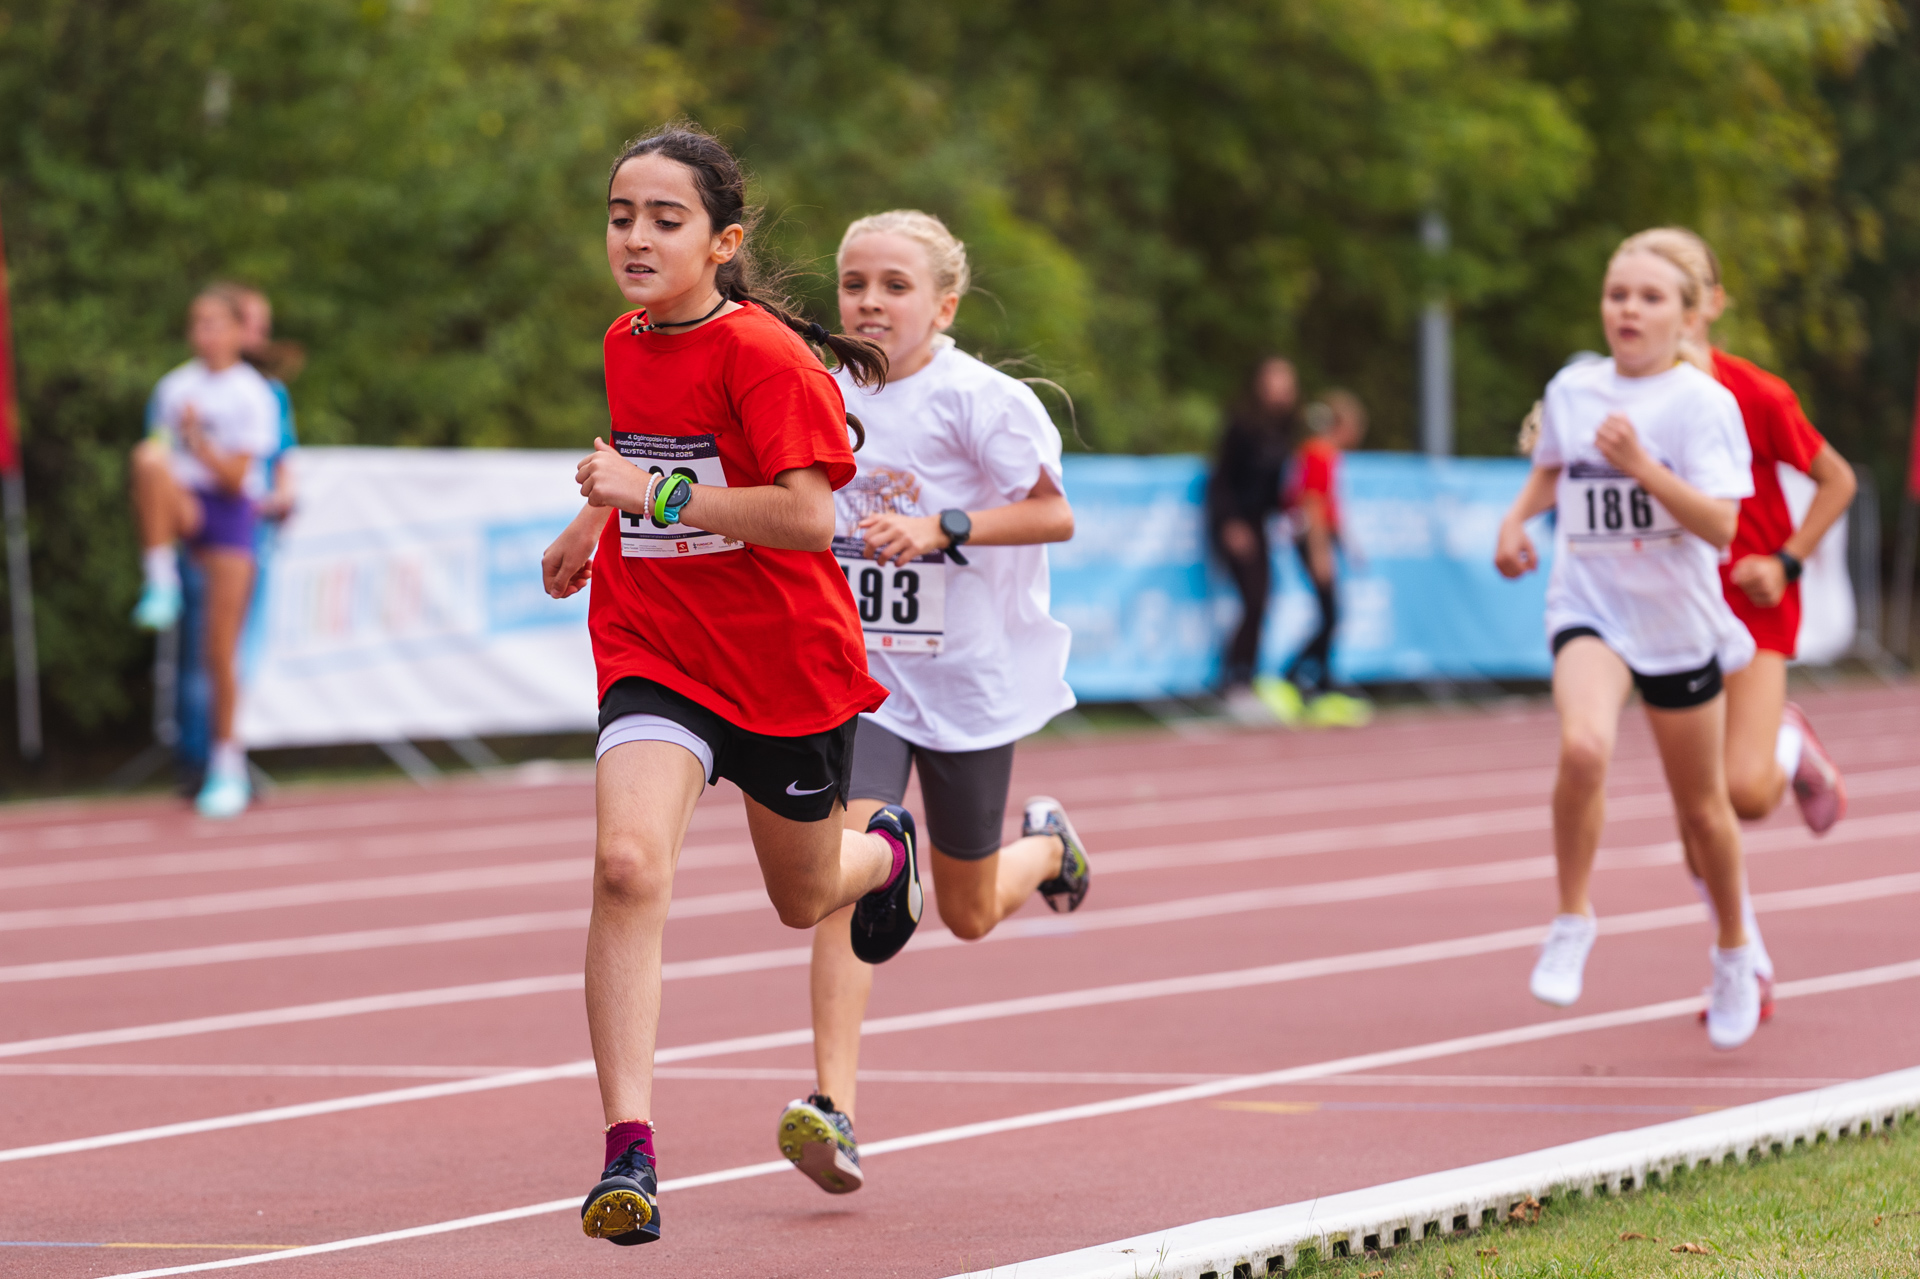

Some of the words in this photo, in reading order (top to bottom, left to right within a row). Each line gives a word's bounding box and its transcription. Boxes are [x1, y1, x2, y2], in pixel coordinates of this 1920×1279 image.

[670, 441, 710, 450] Olimpijskich
[1586, 487, 1653, 530] 186
[839, 565, 919, 624] 93
